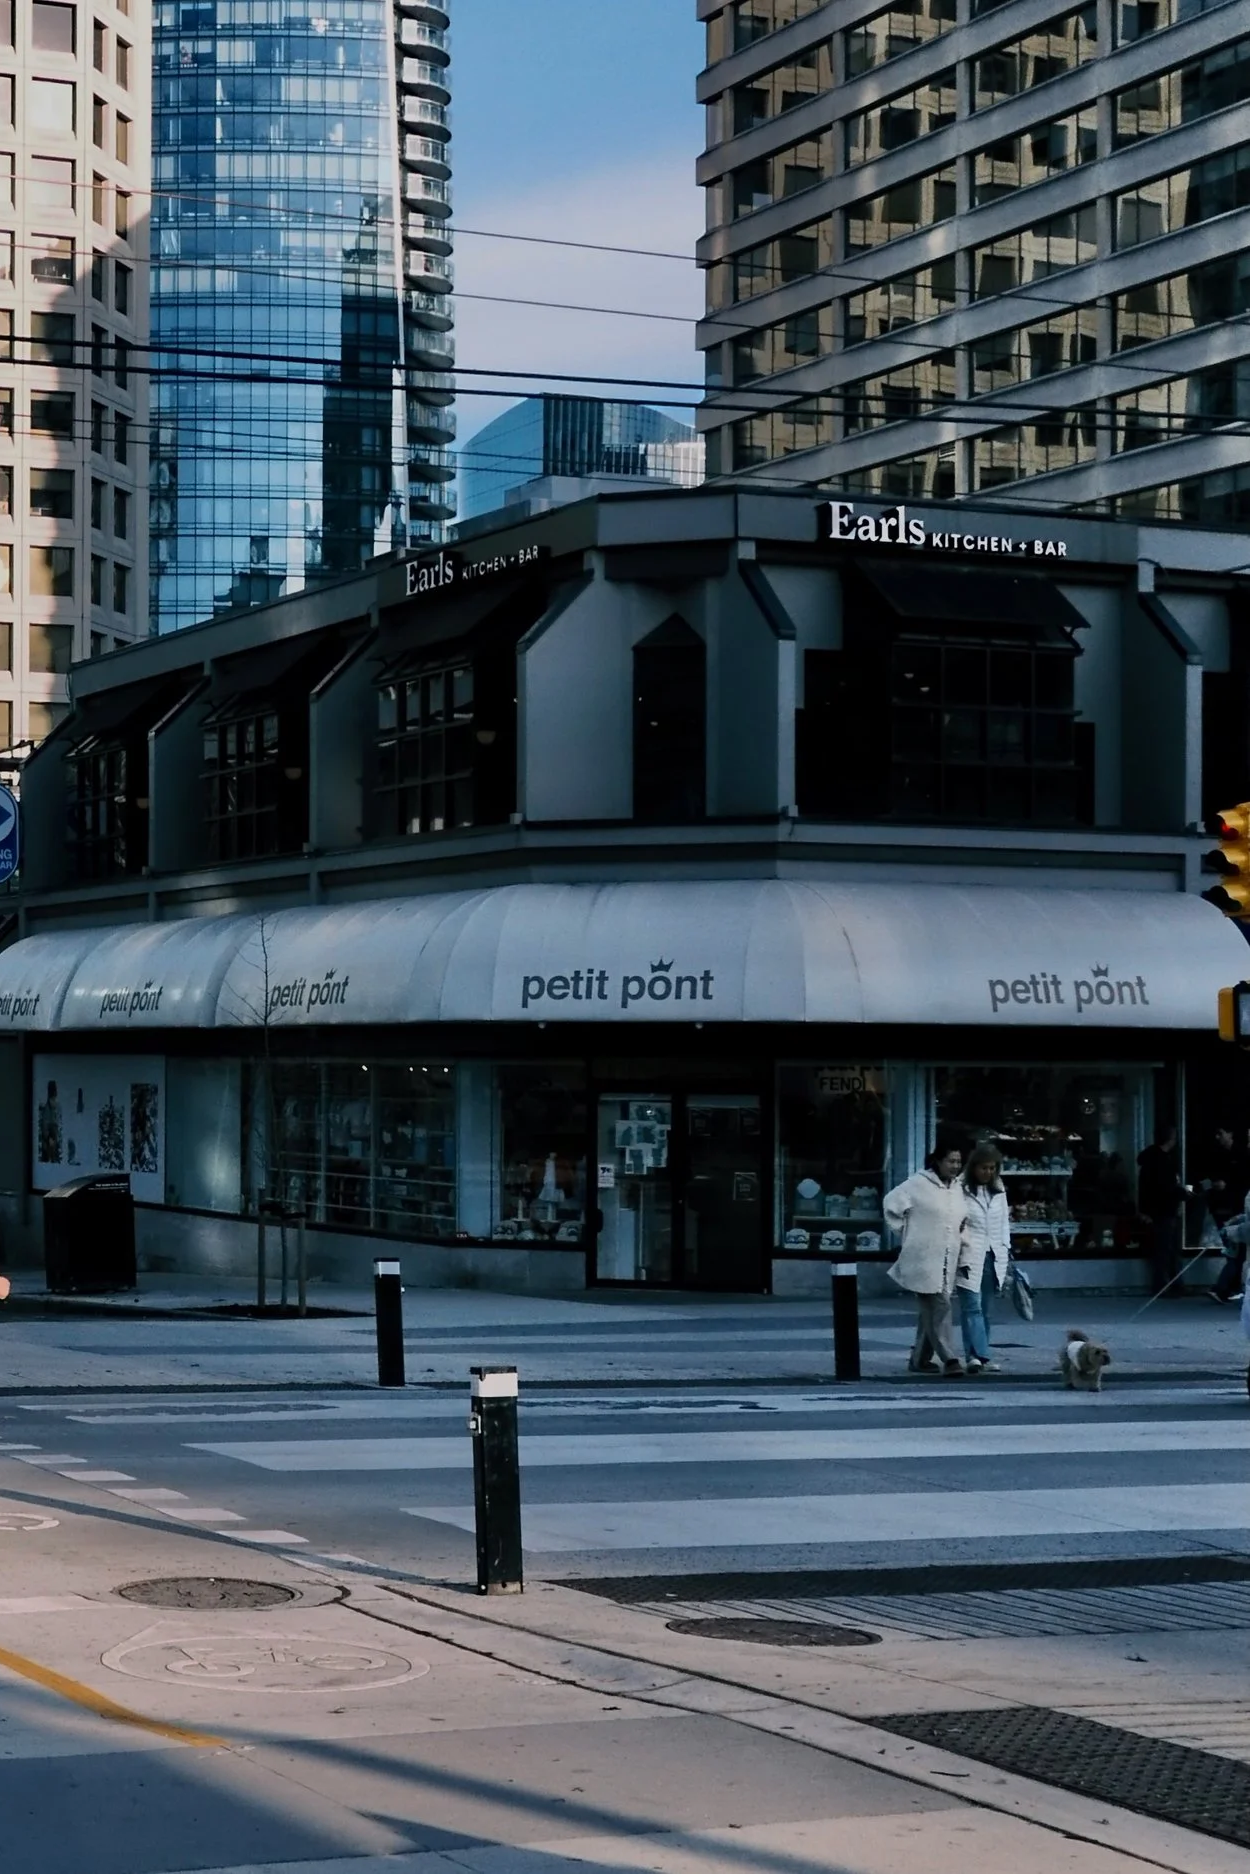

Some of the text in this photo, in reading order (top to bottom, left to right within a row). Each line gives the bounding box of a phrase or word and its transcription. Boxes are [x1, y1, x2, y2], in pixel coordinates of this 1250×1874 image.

[829, 501, 926, 545] Earls
[932, 532, 1012, 552] KITCHEN
[1034, 540, 1067, 556] BAR
[405, 551, 454, 596] Earls
[461, 557, 507, 580] KITCHEN
[518, 545, 539, 564] BAR
[10, 993, 40, 1022] pont
[100, 986, 163, 1018] petit pont
[269, 975, 349, 1014] petit pont
[522, 968, 714, 1008] petit pont
[988, 972, 1150, 1013] petit pont
[820, 1076, 865, 1091] FENDI
